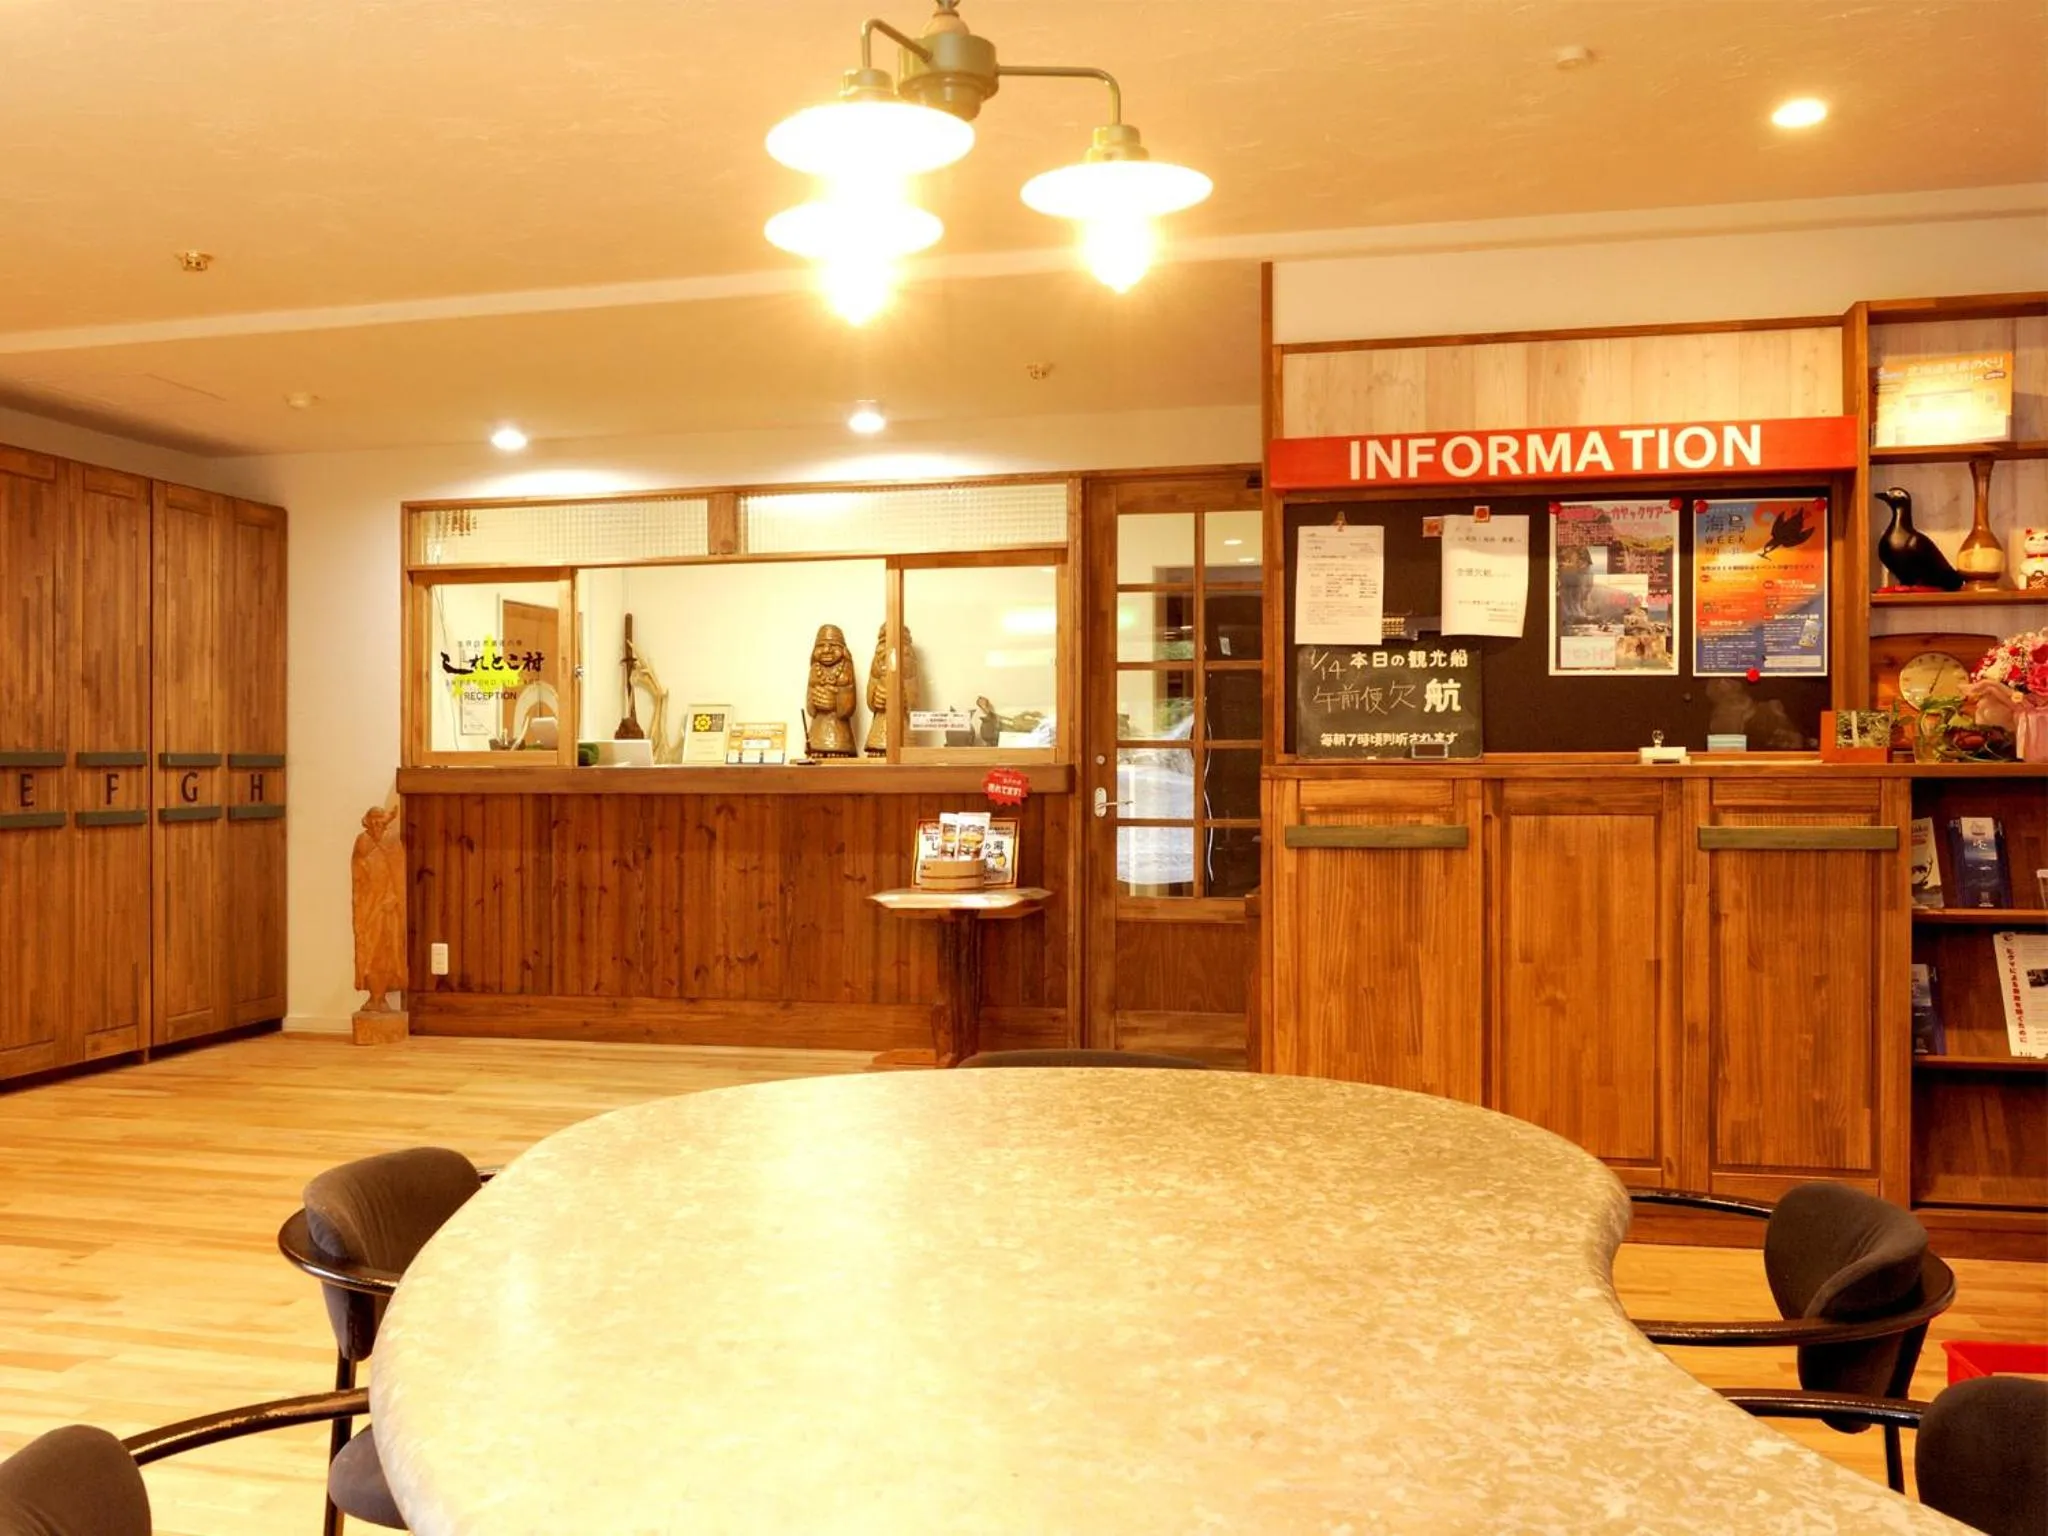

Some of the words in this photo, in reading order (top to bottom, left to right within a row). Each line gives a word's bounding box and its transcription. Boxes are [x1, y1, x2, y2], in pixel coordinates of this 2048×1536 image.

[1349, 424, 1762, 480] INFORMATION
[440, 651, 545, 675] しれとこ村
[1350, 649, 1469, 669] 本日の観光船
[463, 691, 517, 701] RECEPTION
[19, 773, 34, 807] E
[106, 773, 119, 805] F
[181, 772, 198, 802] G
[250, 774, 263, 802] H
